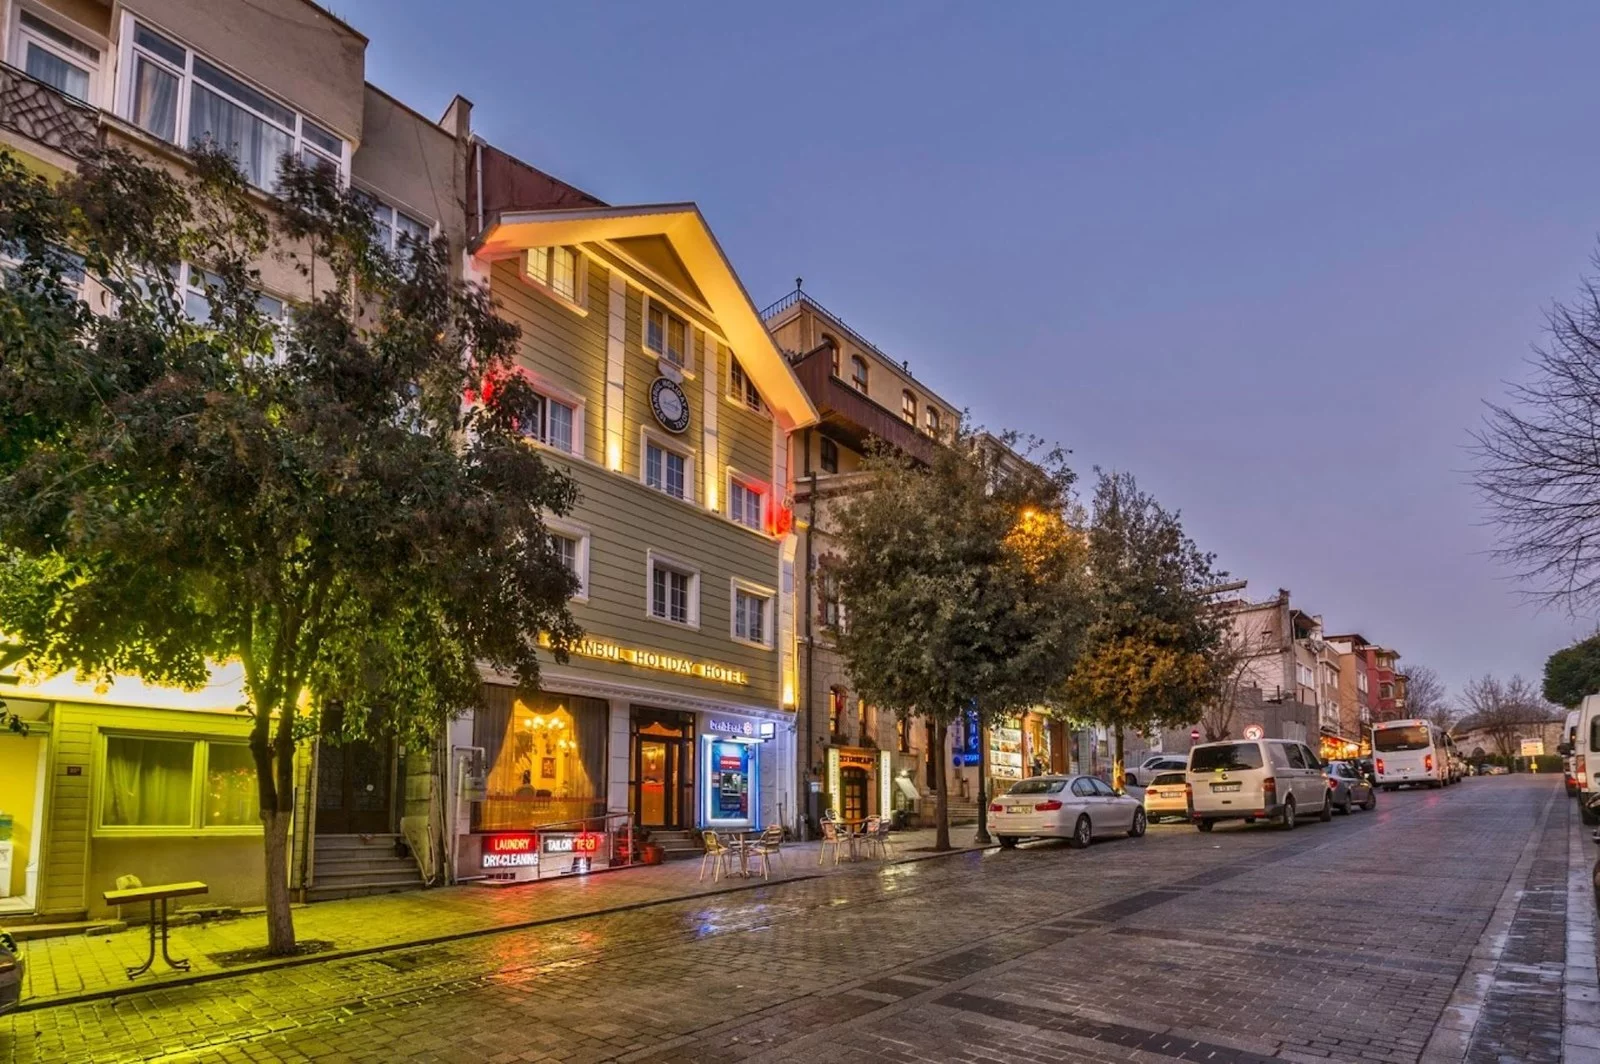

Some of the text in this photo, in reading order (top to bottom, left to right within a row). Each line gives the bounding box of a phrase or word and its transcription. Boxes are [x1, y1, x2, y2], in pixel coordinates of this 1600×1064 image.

[662, 380, 688, 408] HOLIDAY
[673, 409, 689, 429] HOTEL
[553, 636, 748, 685] ANBUL HOLIDAY HOTEL
[494, 838, 531, 851] LAUNDRY
[546, 838, 573, 851] TAILOR
[483, 852, 539, 868] DRY-CLEANING
